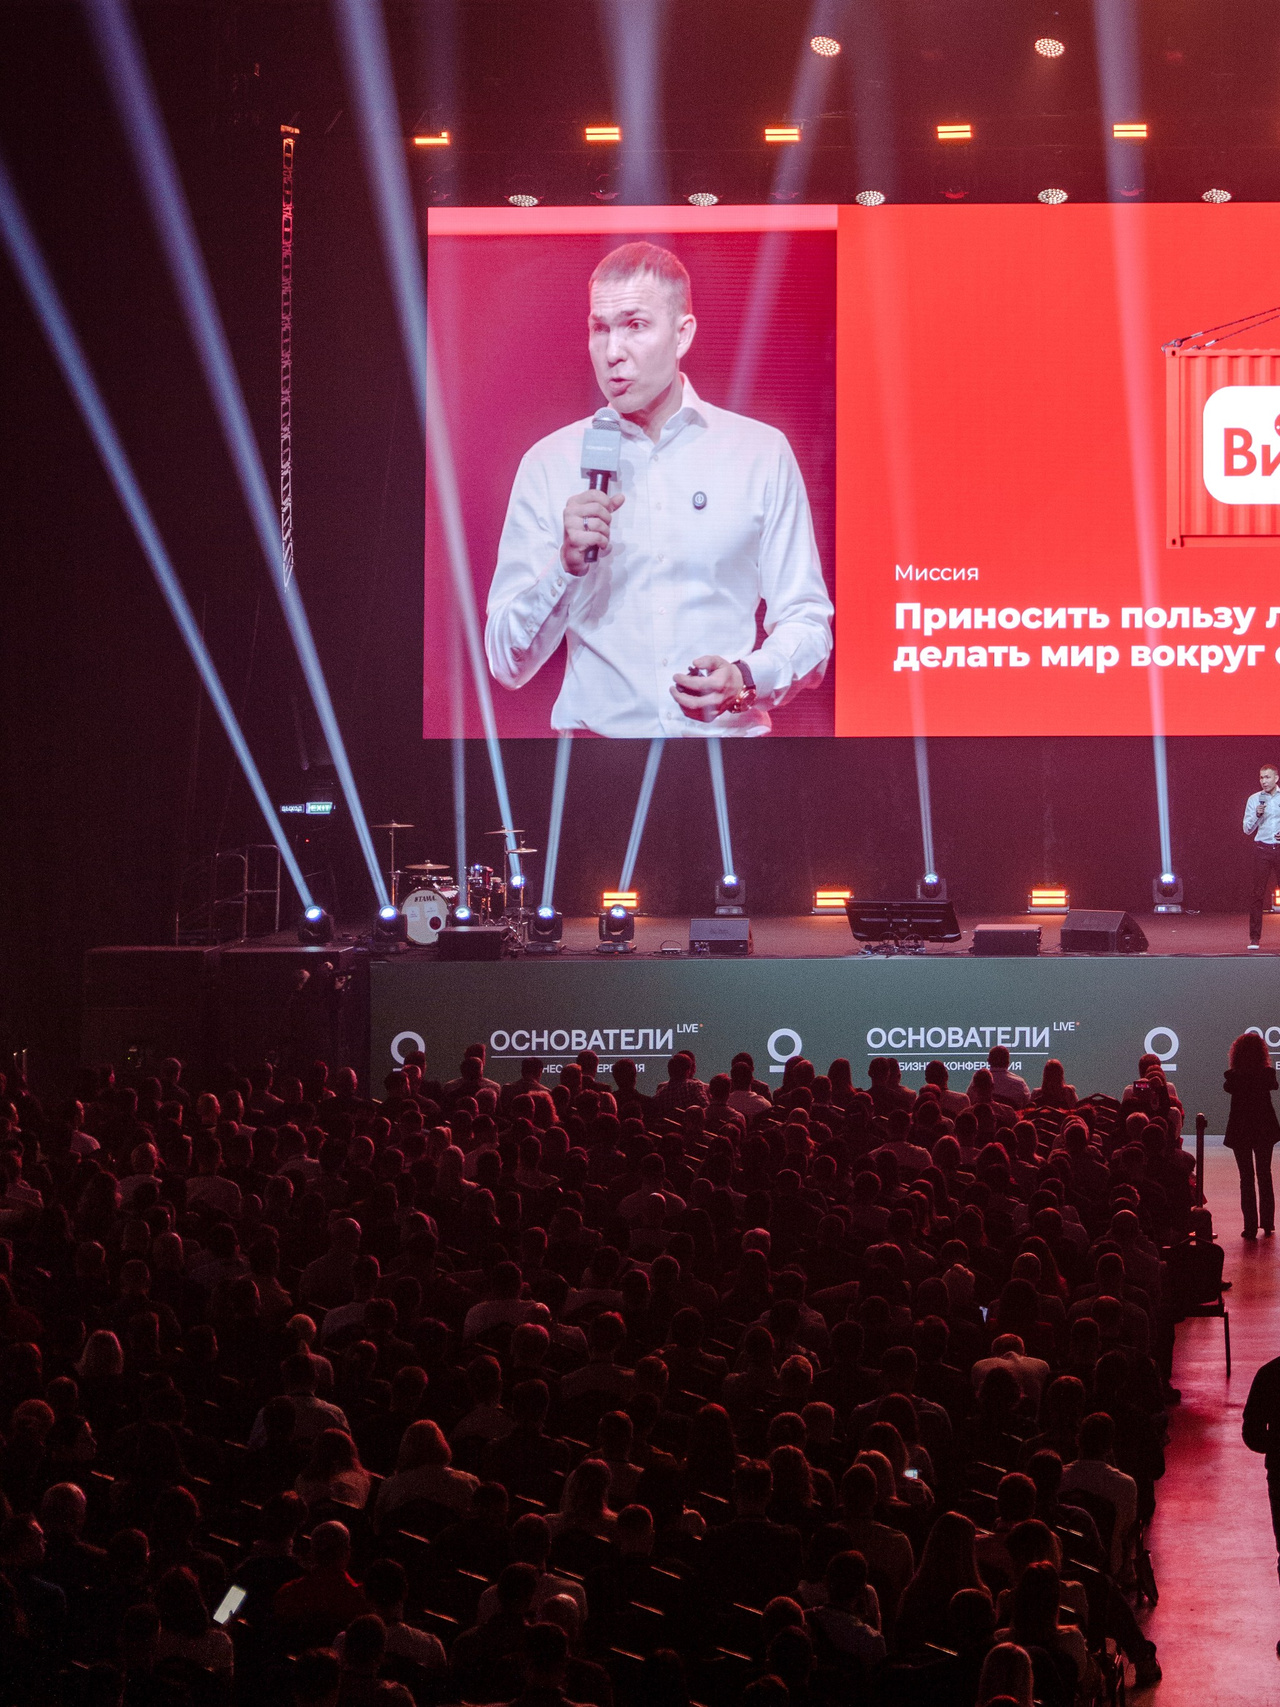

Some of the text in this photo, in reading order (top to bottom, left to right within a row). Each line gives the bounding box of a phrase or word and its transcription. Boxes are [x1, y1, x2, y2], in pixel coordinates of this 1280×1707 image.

[895, 564, 979, 581] Миссия
[895, 602, 1110, 637] Приносить
[1121, 606, 1257, 636] пользу
[893, 645, 1031, 672] делать
[1041, 645, 1120, 674] мир
[1130, 644, 1266, 674] вокруг
[310, 804, 330, 812] EXIT
[490, 1023, 699, 1051] ОСНОВАТЕЛИ LIVE
[866, 1021, 1076, 1049] ОСНОВАТЕЛИ LIVE
